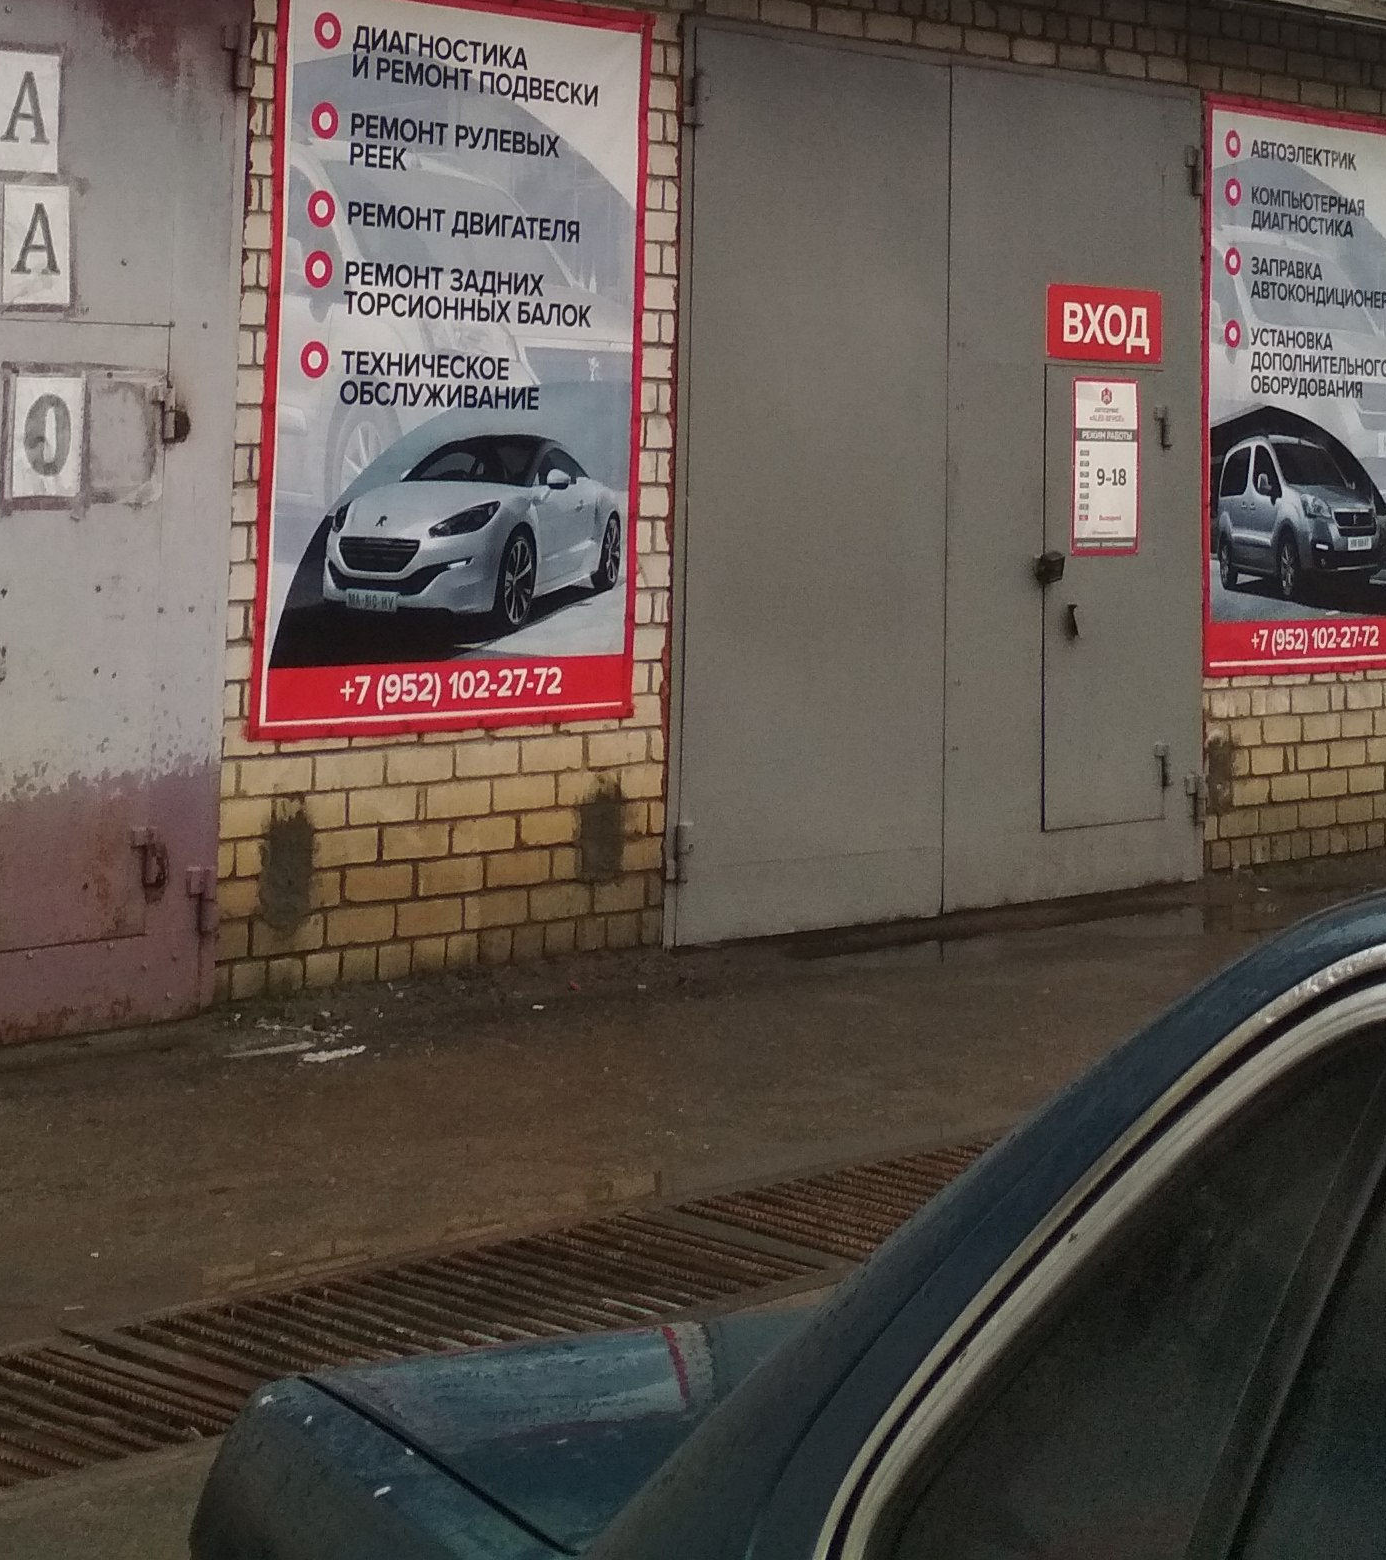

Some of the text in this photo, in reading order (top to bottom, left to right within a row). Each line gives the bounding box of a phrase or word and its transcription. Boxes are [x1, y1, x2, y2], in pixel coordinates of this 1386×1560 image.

[353, 25, 528, 71] ДИАГНОСТИКА
[353, 55, 600, 107] И РЕМОНТ ПОДВЕСКИ
[350, 113, 560, 158] РЕМОНТ РУЛЕВЫХ
[349, 143, 408, 171] РЕЕК
[1250, 140, 1358, 172] АВТОЭЛЕКТРИК
[1251, 186, 1365, 218] КОМПЬЮТЕРНАЯ
[347, 201, 581, 243] РЕМОНТ ДВИГАТЕЛЯ
[1251, 209, 1354, 239] ДИАГНОСТИКА
[344, 260, 544, 299] РЕМОНТ ЗАДНИХ
[1251, 256, 1323, 281] ЗАПРАВКА
[343, 290, 592, 328] ТОРСИОННЫХ БАЛОК
[1063, 301, 1150, 355] ВХОД
[1250, 327, 1333, 351] УСТАНОВКА
[341, 350, 510, 382] ТЕХНИЧЕСКОЕ
[339, 381, 540, 411] ОБСЛУЖИВАНИЕ
[1250, 374, 1364, 400] ОБОРУДОВАНИЯ
[1096, 468, 1127, 487] 9-18
[1251, 625, 1379, 656] +7 (952) 102-27-72
[339, 666, 563, 711] +7 (952) 102-27-72
